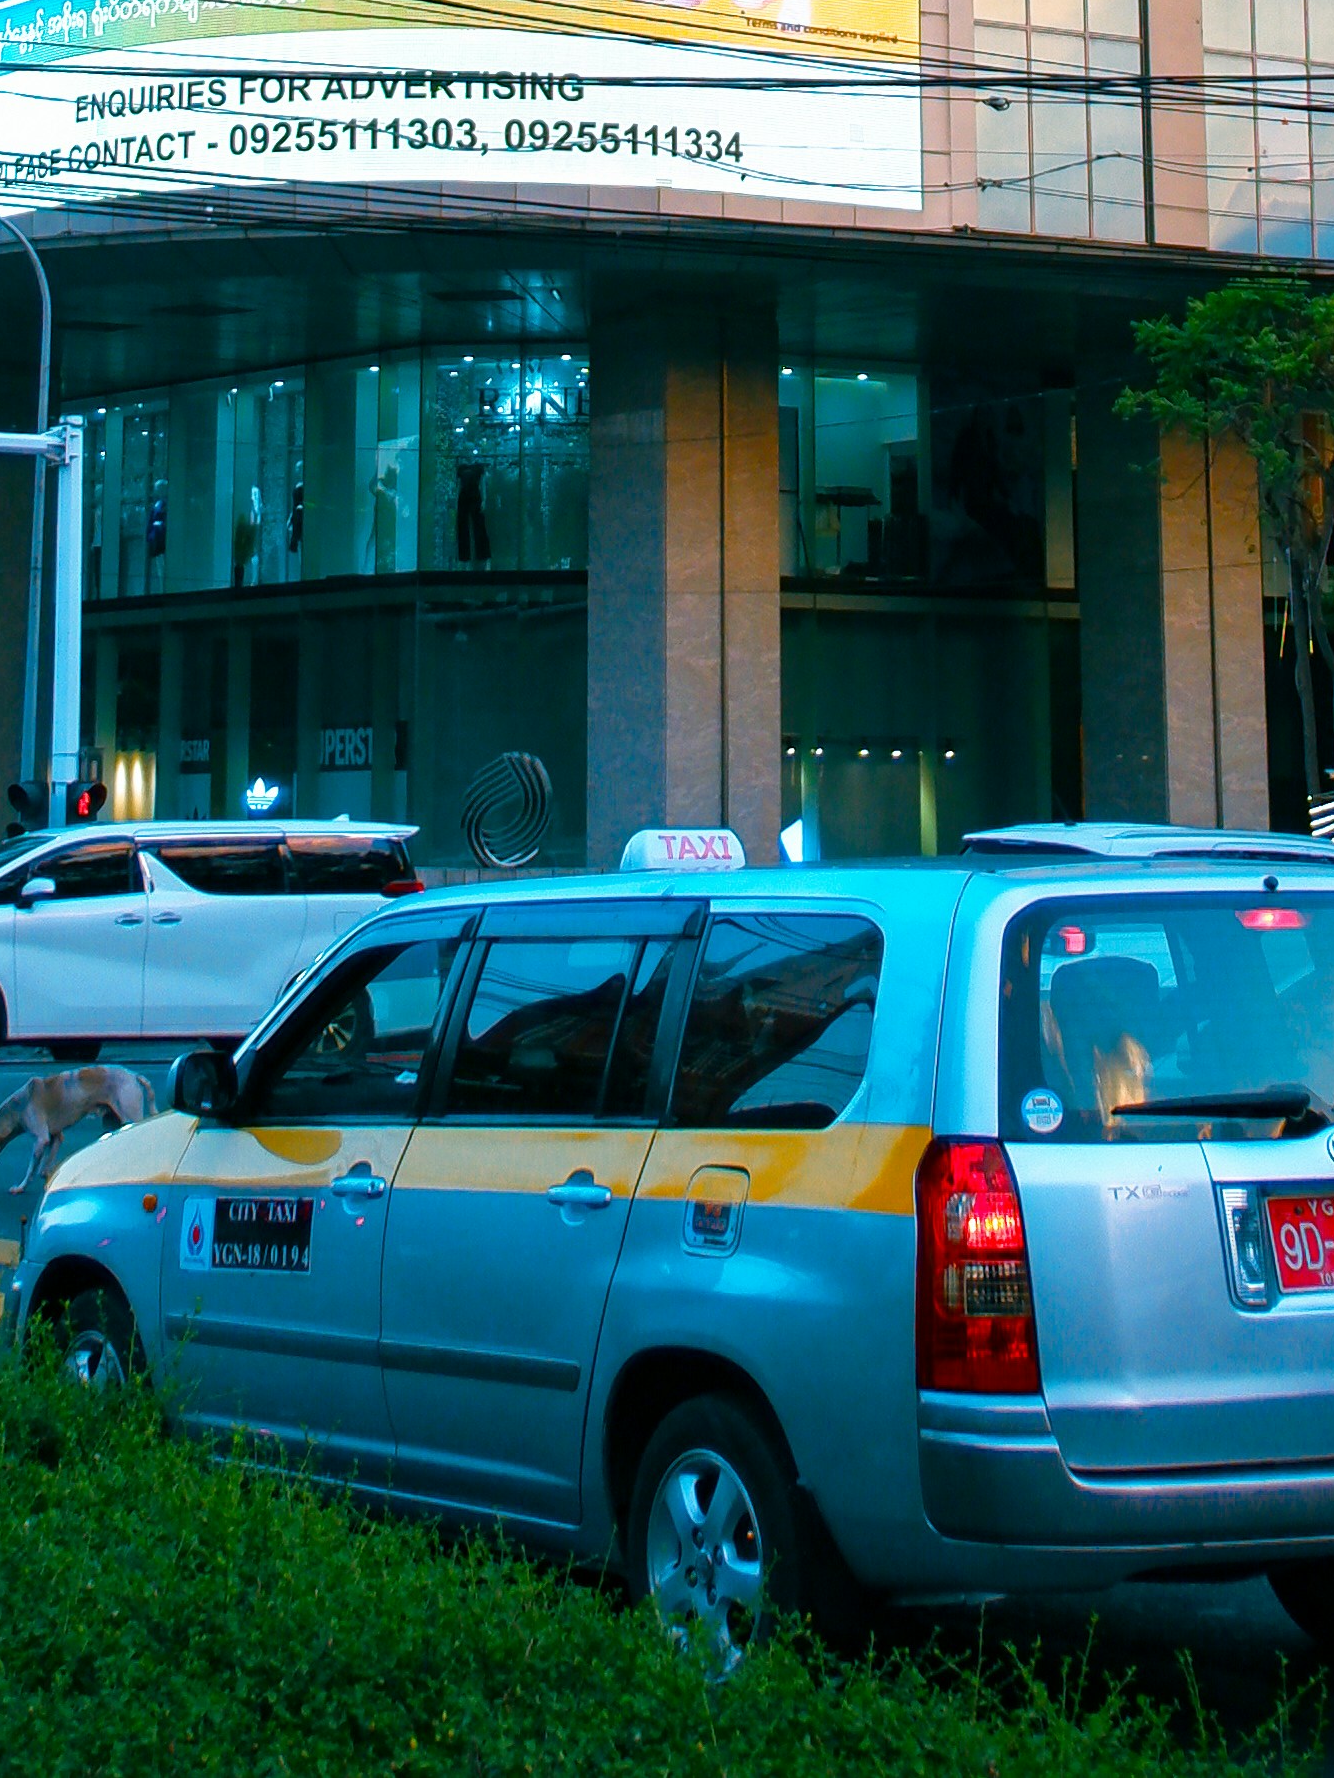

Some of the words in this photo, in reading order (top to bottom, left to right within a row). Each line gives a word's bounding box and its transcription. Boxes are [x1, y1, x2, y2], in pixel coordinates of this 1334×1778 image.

[781, 22, 801, 33] and
[75, 78, 227, 123] ENQUIRIES
[239, 76, 313, 107] FOR
[321, 71, 584, 102] ADVERTISING
[68, 130, 196, 172] CONTACT
[229, 117, 488, 157] 09255111303,
[505, 117, 744, 163] 09255111334
[658, 835, 732, 860] TAXI
[228, 1201, 259, 1222] CITY
[267, 1202, 297, 1223] TAXI
